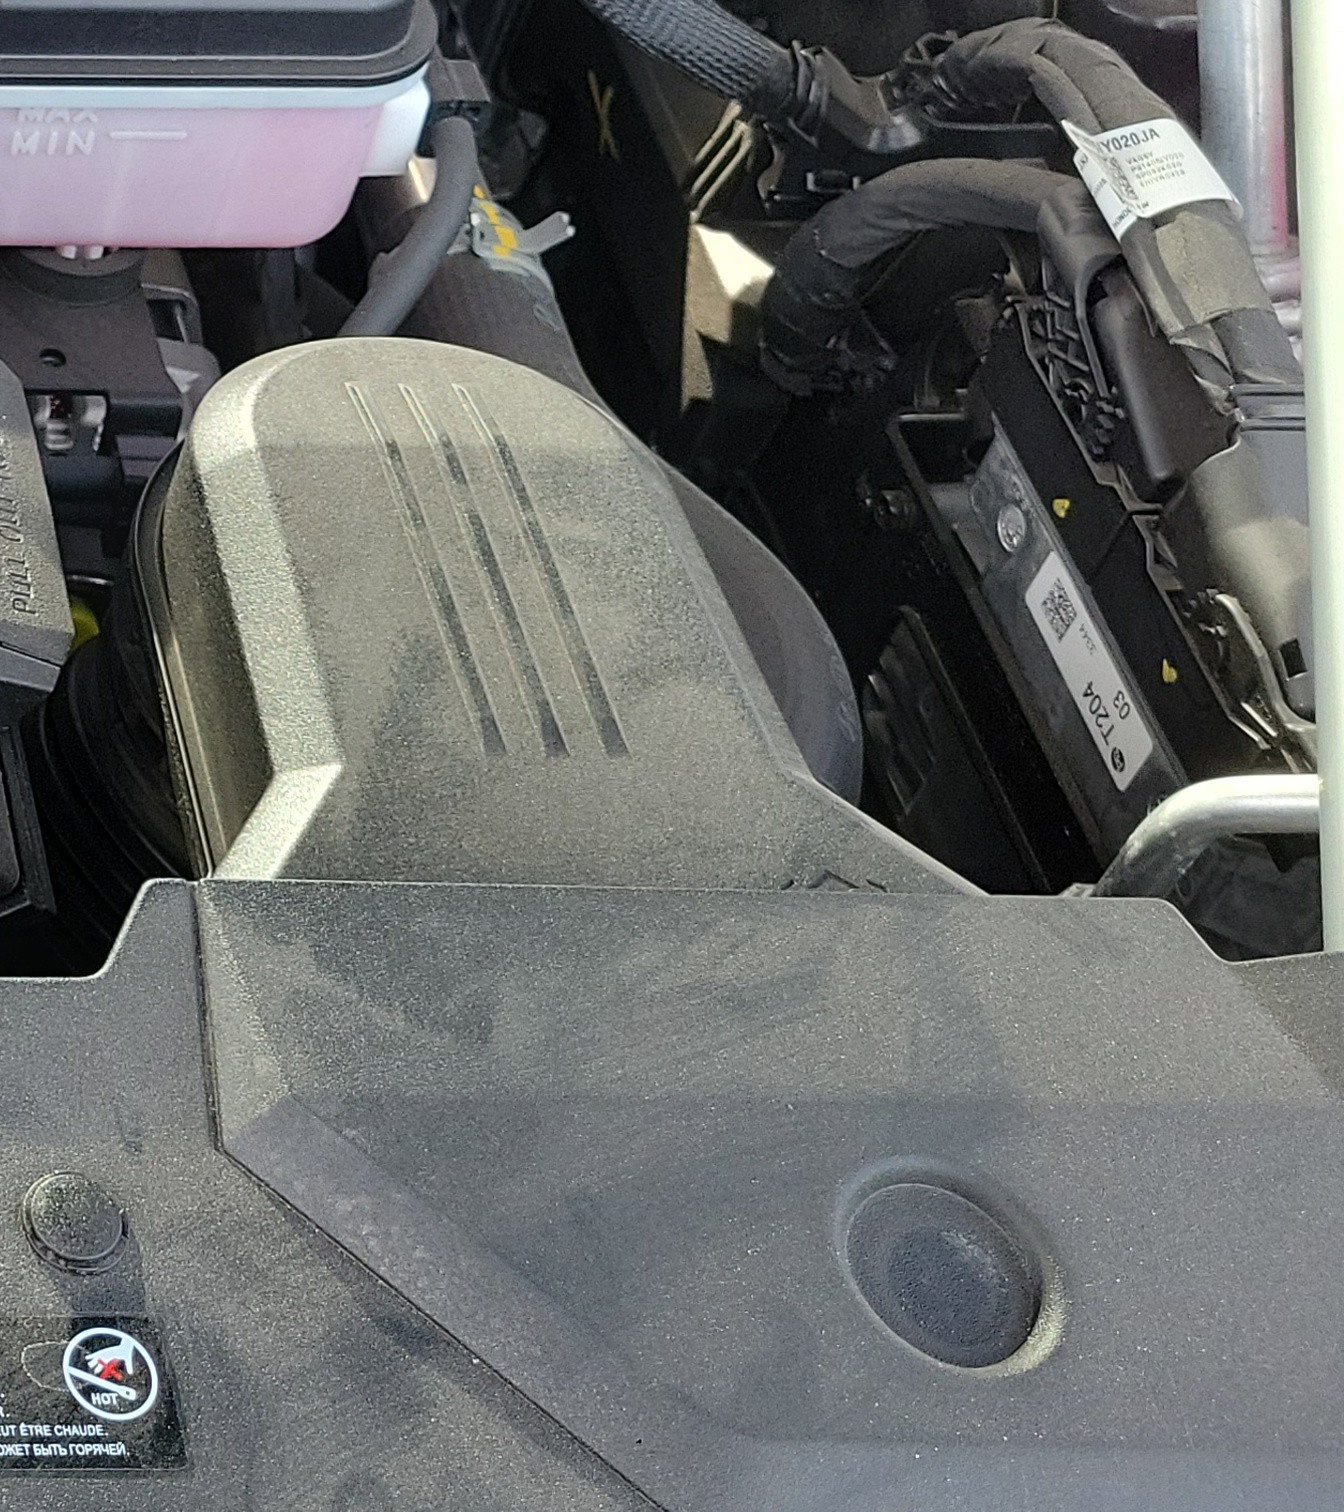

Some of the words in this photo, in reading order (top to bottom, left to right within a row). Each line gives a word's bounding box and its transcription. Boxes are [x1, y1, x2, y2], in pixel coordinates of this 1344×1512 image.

[11, 130, 96, 155] MIN
[3, 551, 39, 616] PULL
[1082, 681, 1116, 745] T204
[1112, 690, 1131, 720] 03
[90, 1392, 118, 1405] HOT
[19, 1422, 53, 1436] ÊTRE
[54, 1425, 109, 1437] CHAUDE.
[33, 1443, 68, 1456] БЫТЬ
[69, 1441, 130, 1457] ГОРЯЧЕЙ.
